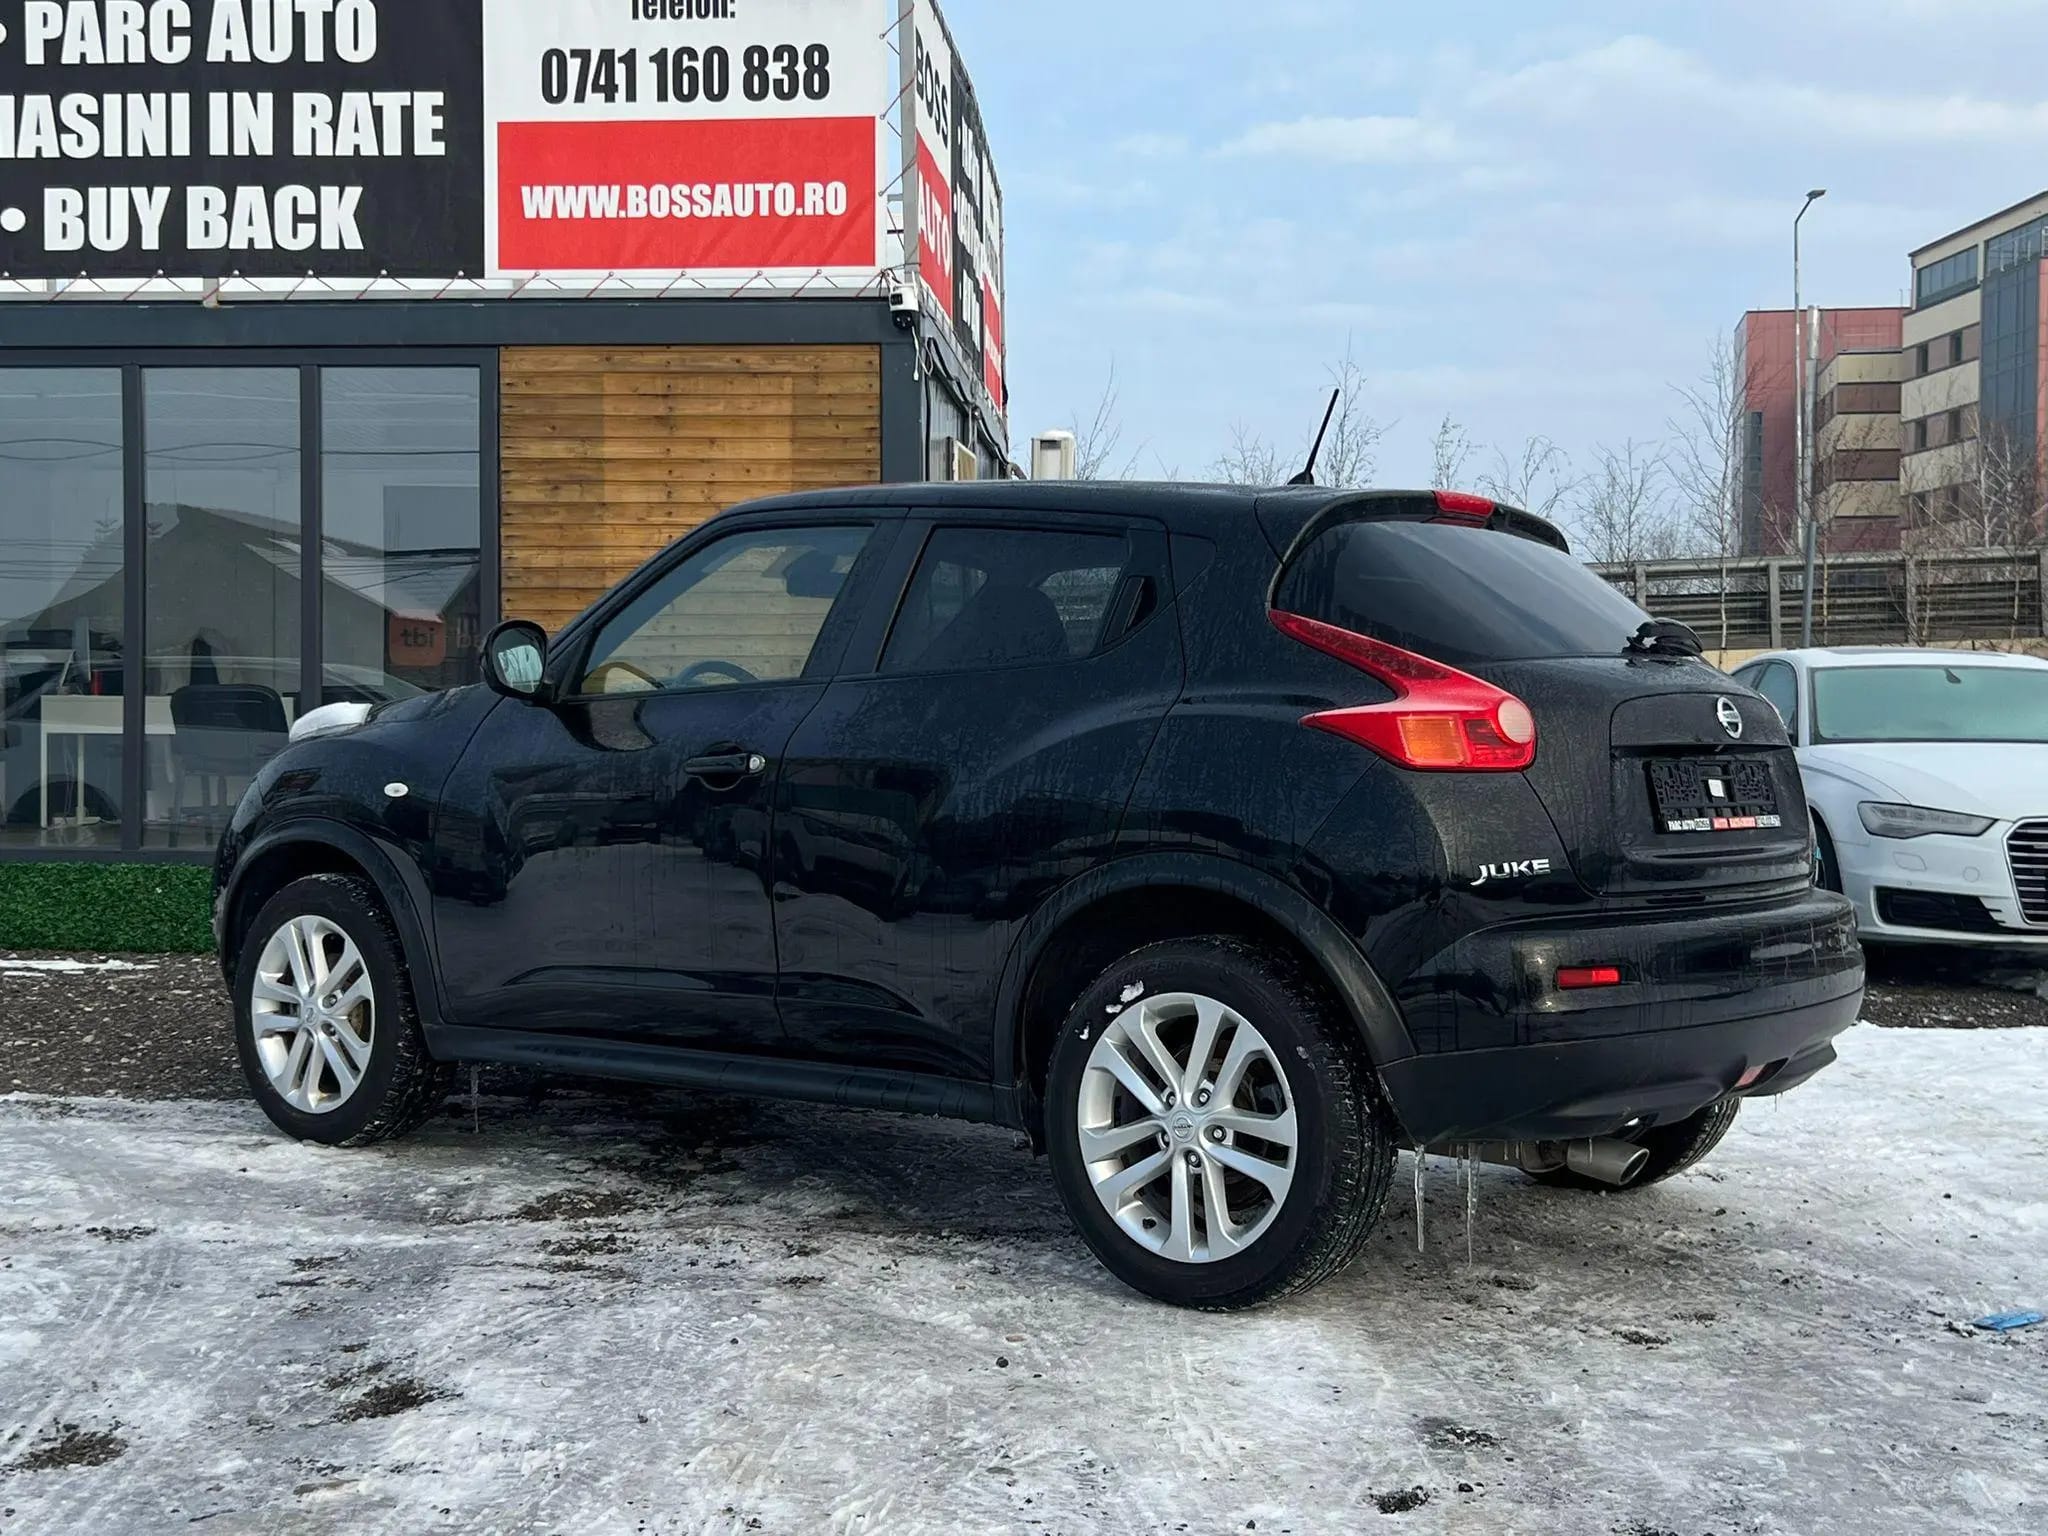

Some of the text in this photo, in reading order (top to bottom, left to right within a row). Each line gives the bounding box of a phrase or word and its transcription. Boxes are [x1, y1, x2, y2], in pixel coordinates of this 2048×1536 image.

[24, 0, 378, 65] PARC AUTO
[541, 43, 831, 105] 0741 160 838
[915, 26, 949, 149] BOSS
[208, 92, 274, 157] IN
[292, 91, 446, 156] RATE
[43, 184, 365, 252] BUY BACK
[520, 181, 848, 220] WWW.BOSSAUTO.RO
[917, 170, 951, 277] AUTO
[1470, 858, 1551, 886] JUKE
